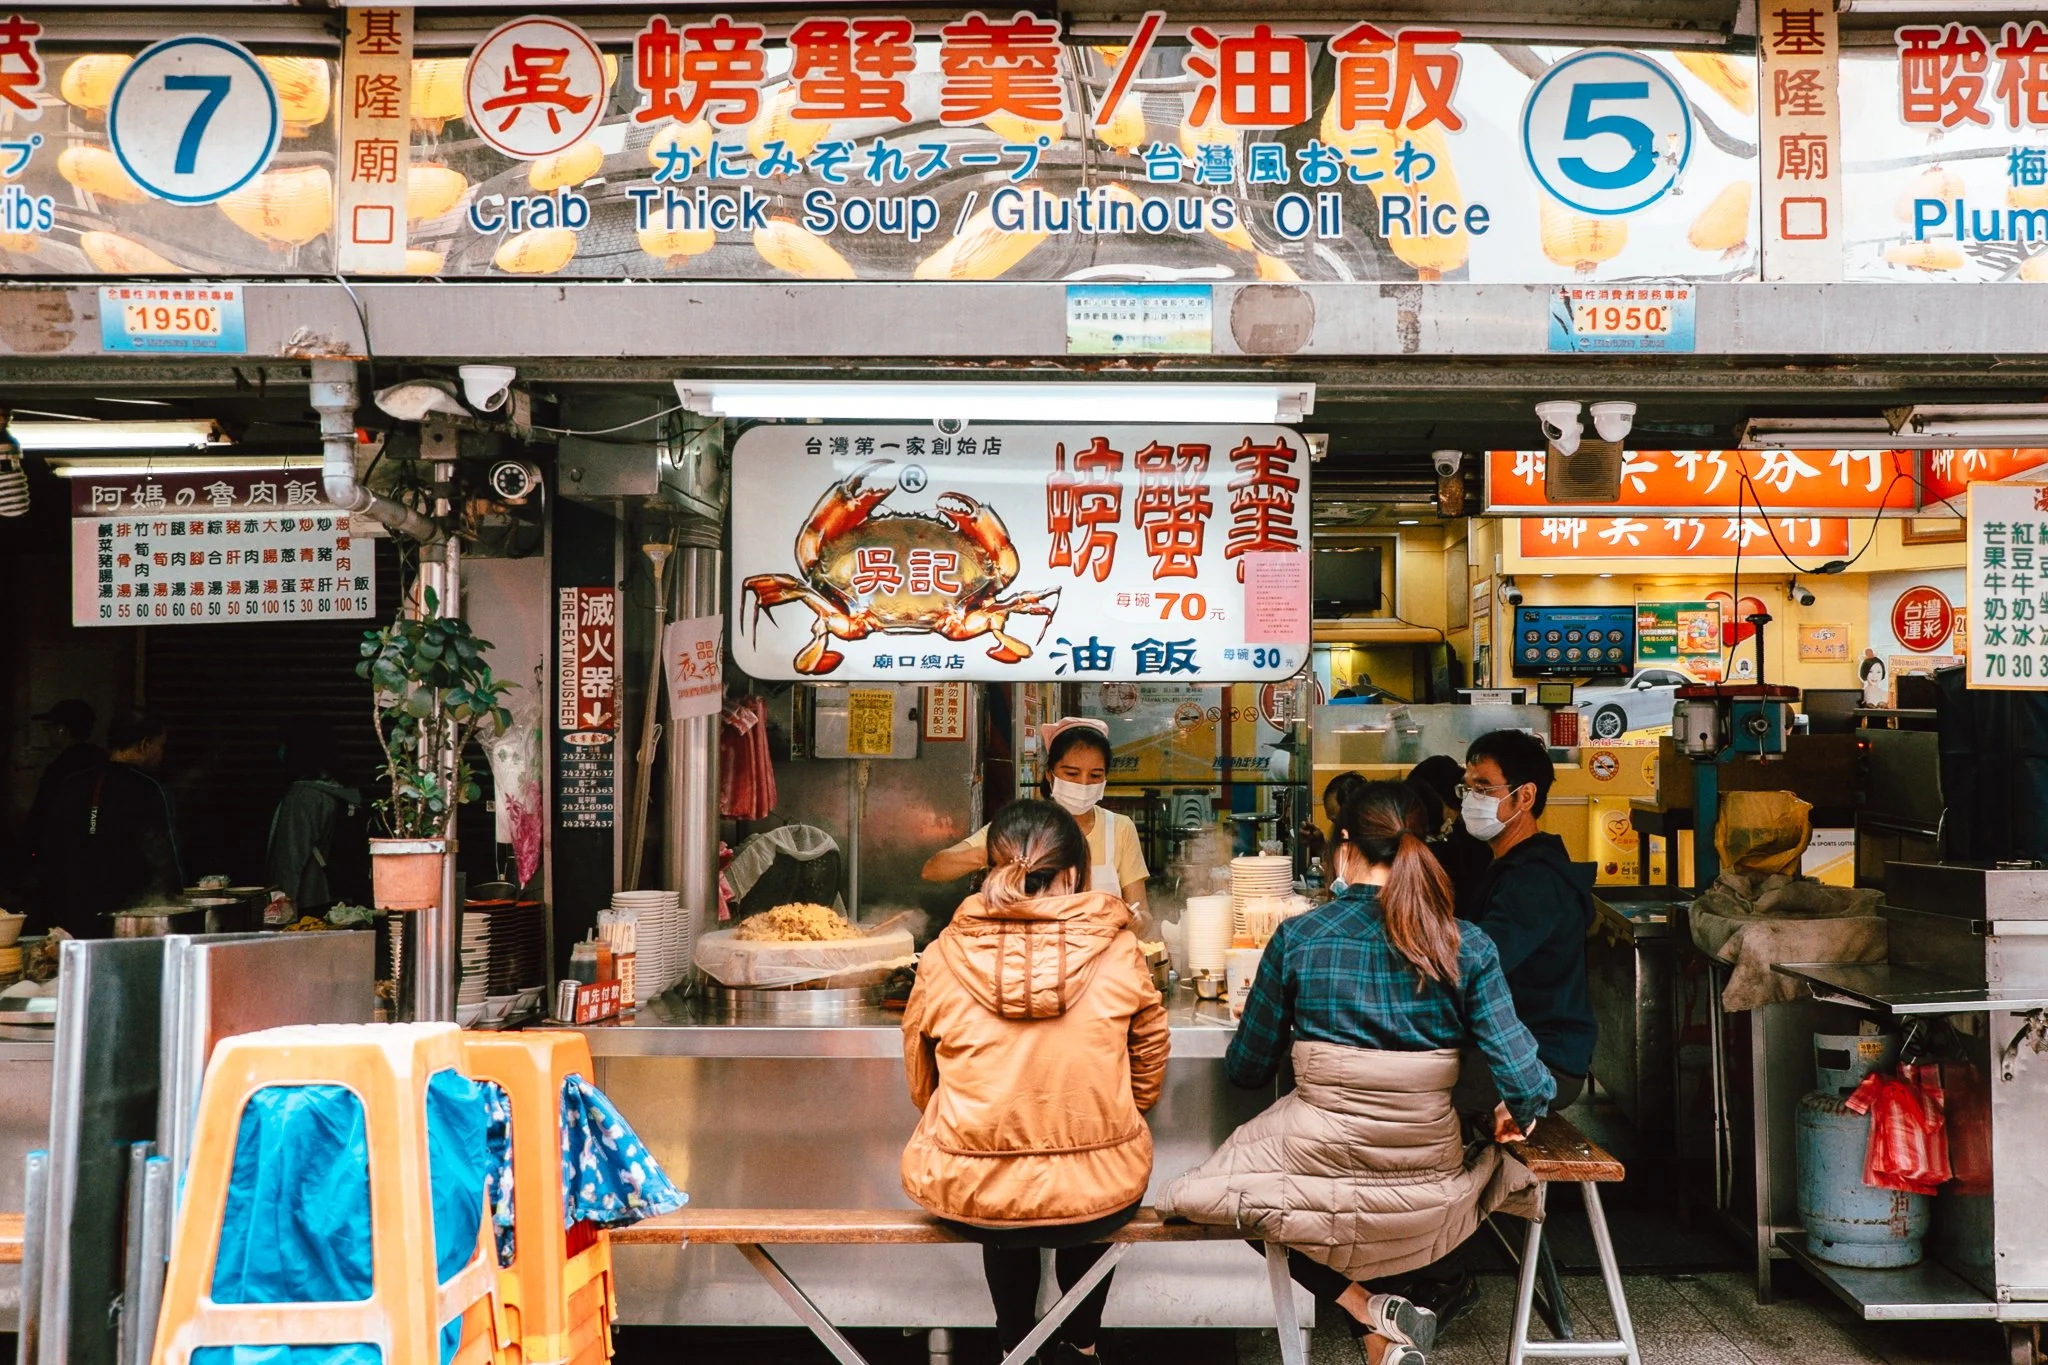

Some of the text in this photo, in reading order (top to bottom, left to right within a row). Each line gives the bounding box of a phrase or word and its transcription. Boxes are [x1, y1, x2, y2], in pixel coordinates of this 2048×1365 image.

[164, 75, 231, 174] 7
[351, 9, 402, 245] 基隆廟口
[1557, 81, 1659, 189] 5
[1773, 8, 1828, 240] 基隆廟口
[653, 138, 1437, 184] かにみぞれスープ 台灣風おこわ
[471, 191, 588, 231] Crab
[627, 189, 767, 230] Thick
[805, 191, 937, 239] Soup
[992, 190, 1235, 232] Glutinous
[1275, 195, 1342, 238] Oil
[1382, 196, 1491, 236] Rice
[135, 307, 210, 331] 1950
[1585, 307, 1661, 331] 1950
[805, 437, 1001, 456] 台灣第一家創始店
[91, 480, 321, 511] 阿媽の魯肉飯
[117, 523, 132, 617] 排骨湯 55
[853, 549, 959, 594] 吳記
[100, 604, 112, 618] 50
[136, 603, 149, 617] 60
[155, 603, 167, 616] 60
[172, 603, 185, 616] 60
[190, 602, 203, 616] 60
[208, 602, 221, 615] 50
[227, 601, 240, 615] 50
[246, 601, 258, 614] 50
[262, 600, 279, 613] 100
[283, 599, 295, 613] 15
[300, 599, 313, 612] 30
[318, 598, 330, 612] 80
[334, 598, 352, 611] 100
[355, 597, 367, 611] 15
[1983, 522, 2007, 677] 芒果牛奶冰 70
[2011, 522, 2035, 677] 紅豆牛奶冰 30
[581, 592, 614, 698] 滅火器
[1049, 636, 1202, 676] 油飯
[562, 591, 575, 726] FIRE-EXTINGUISHER
[873, 654, 965, 669] 廟口總店
[933, 685, 944, 734] 謝您的配合
